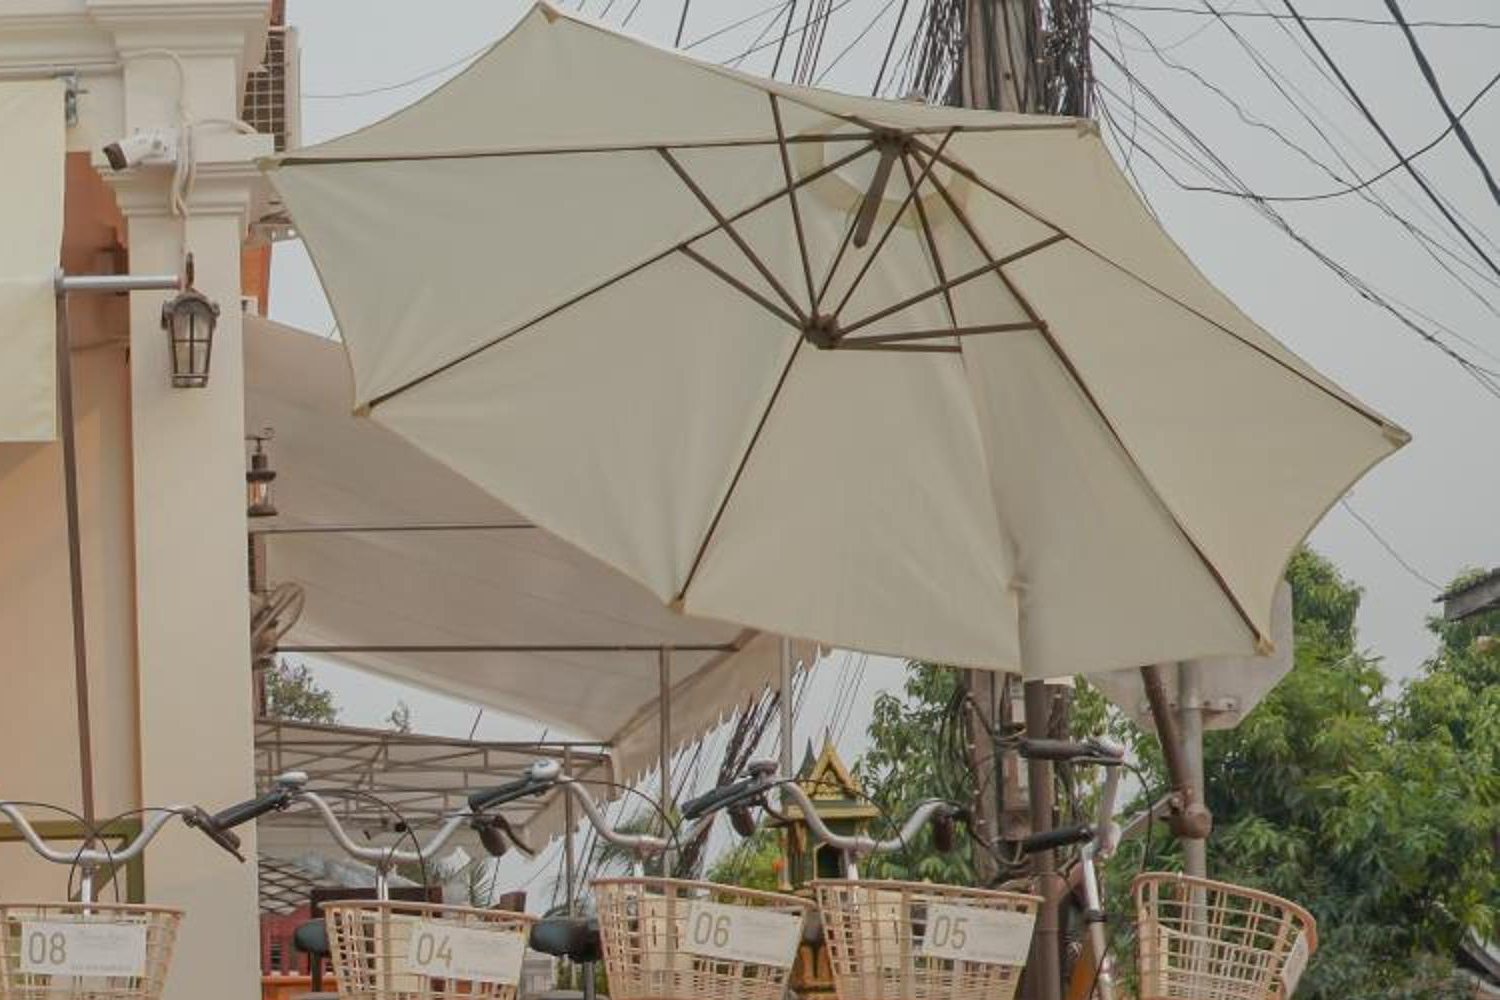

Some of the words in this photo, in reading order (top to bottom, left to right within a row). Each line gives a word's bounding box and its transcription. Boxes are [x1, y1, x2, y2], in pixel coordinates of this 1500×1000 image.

[694, 911, 732, 948] 06
[932, 915, 969, 950] 05
[28, 931, 67, 966] 08
[416, 932, 453, 967] 04
